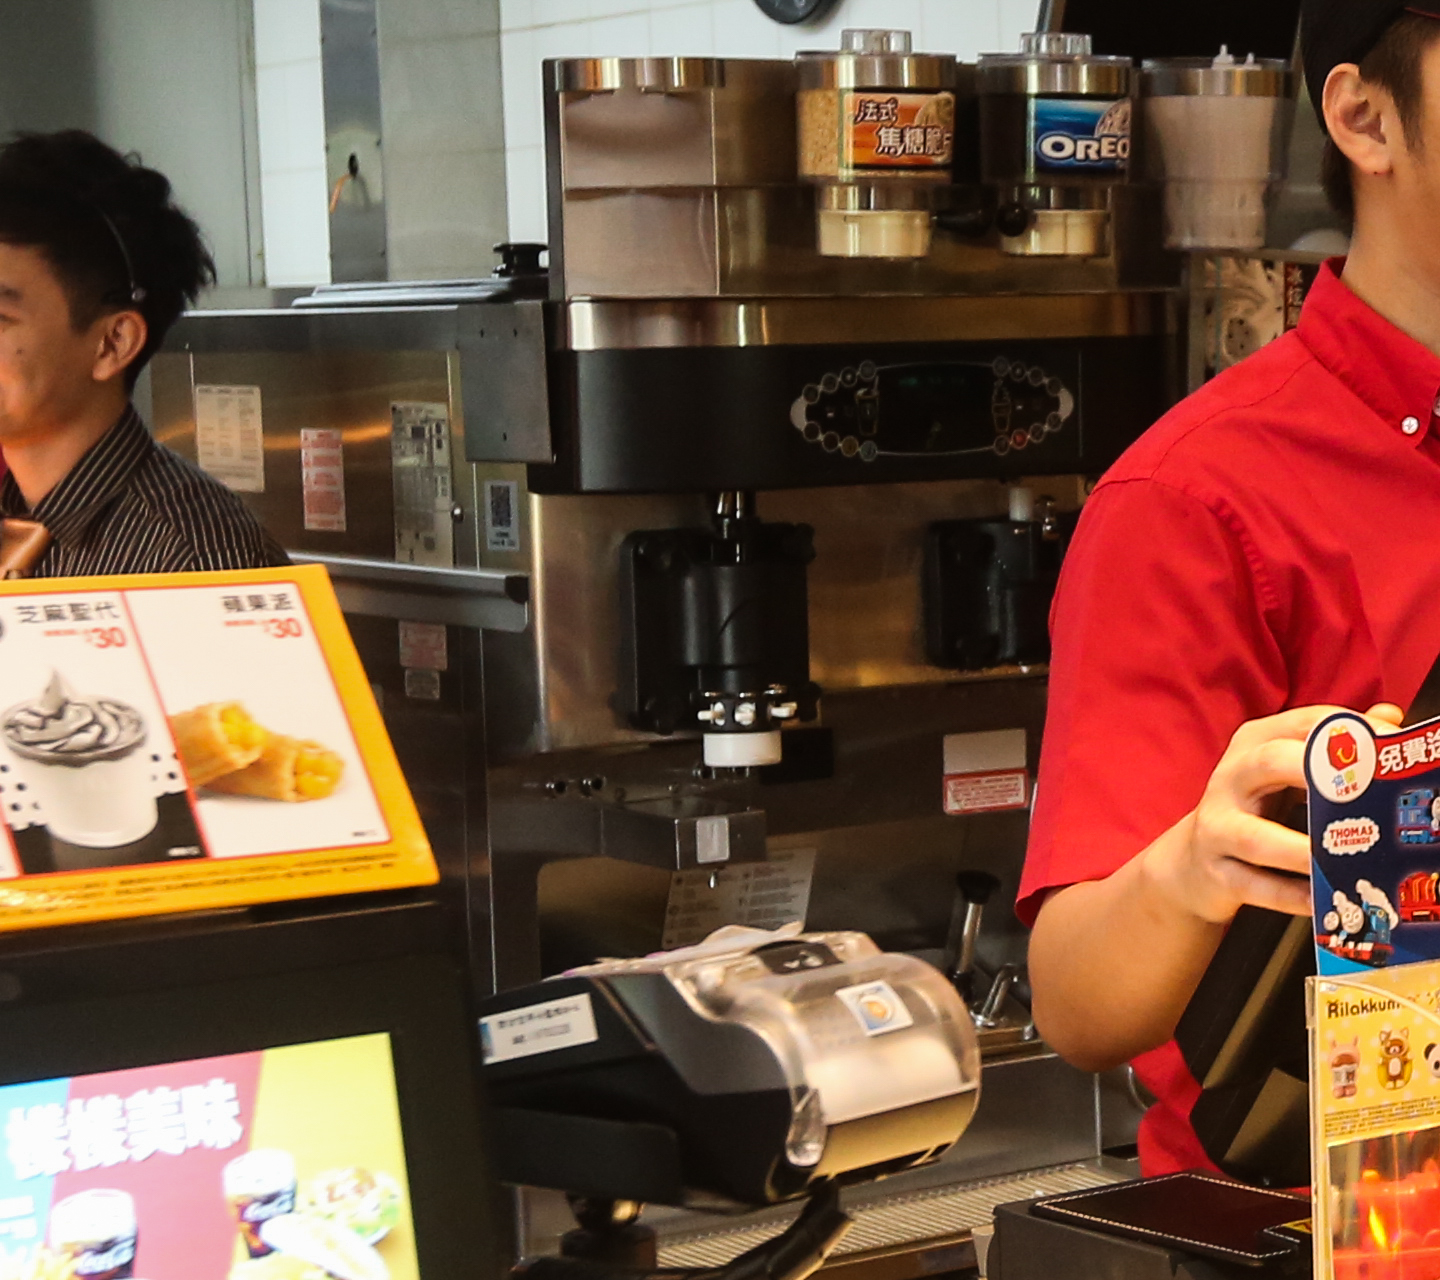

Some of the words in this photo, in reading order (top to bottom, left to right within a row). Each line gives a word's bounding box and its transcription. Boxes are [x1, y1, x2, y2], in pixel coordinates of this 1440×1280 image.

[854, 98, 897, 124] 法式
[1328, 824, 1375, 842] THOMAS
[1340, 836, 1371, 848] FRIENDS
